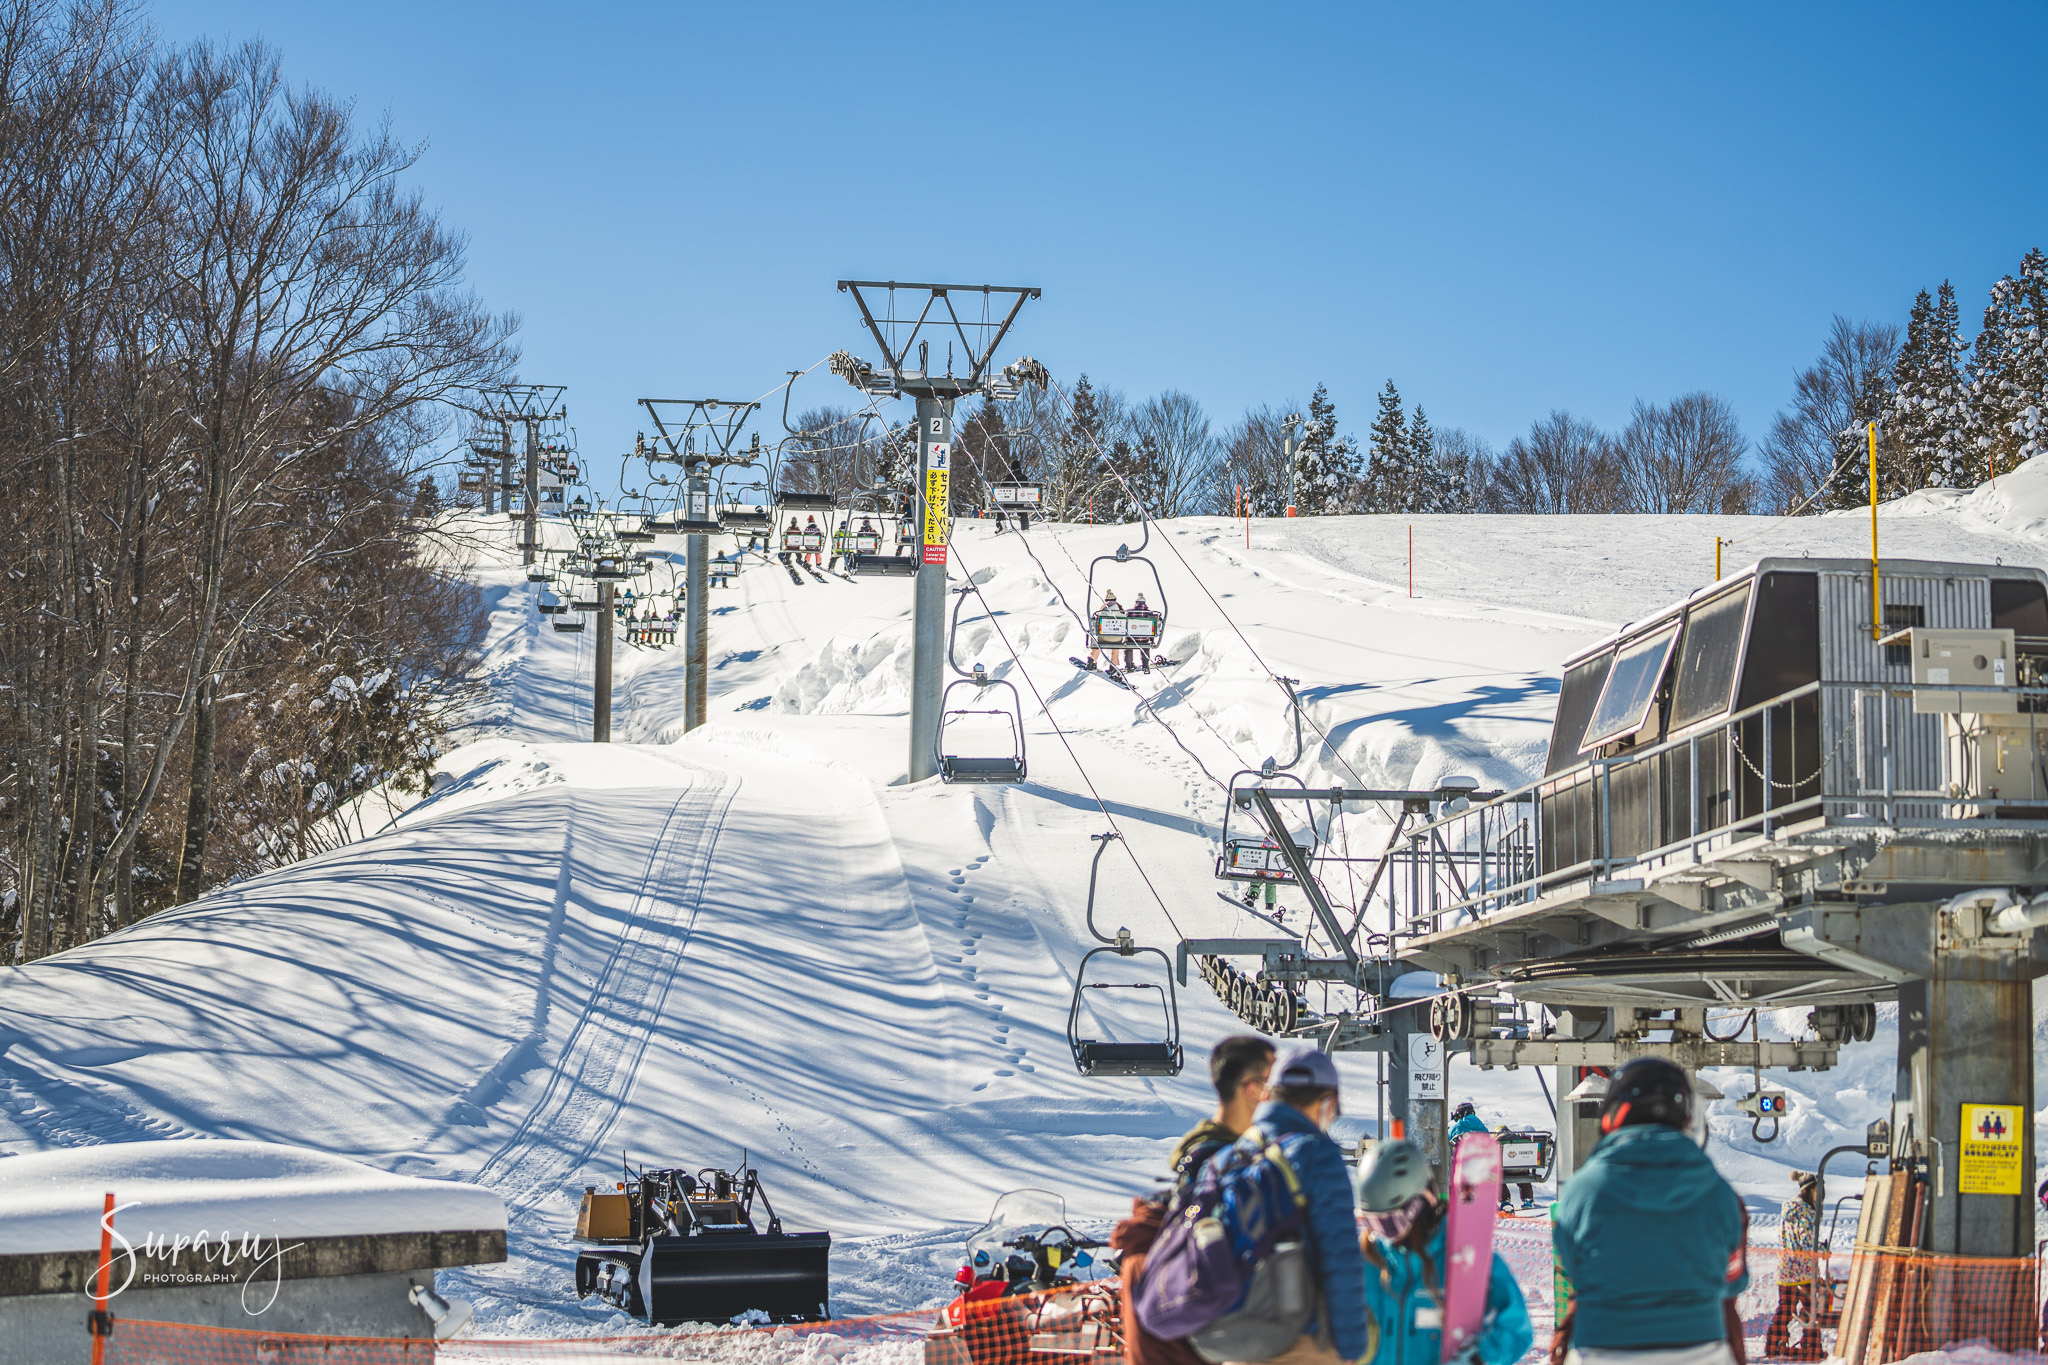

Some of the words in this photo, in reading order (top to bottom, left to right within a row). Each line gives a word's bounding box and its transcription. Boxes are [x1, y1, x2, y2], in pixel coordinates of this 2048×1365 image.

[932, 420, 941, 432] 2
[1414, 1072, 1441, 1082] 飛び降り
[1421, 1082, 1436, 1091] 禁止
[1872, 1143, 1883, 1151] 21
